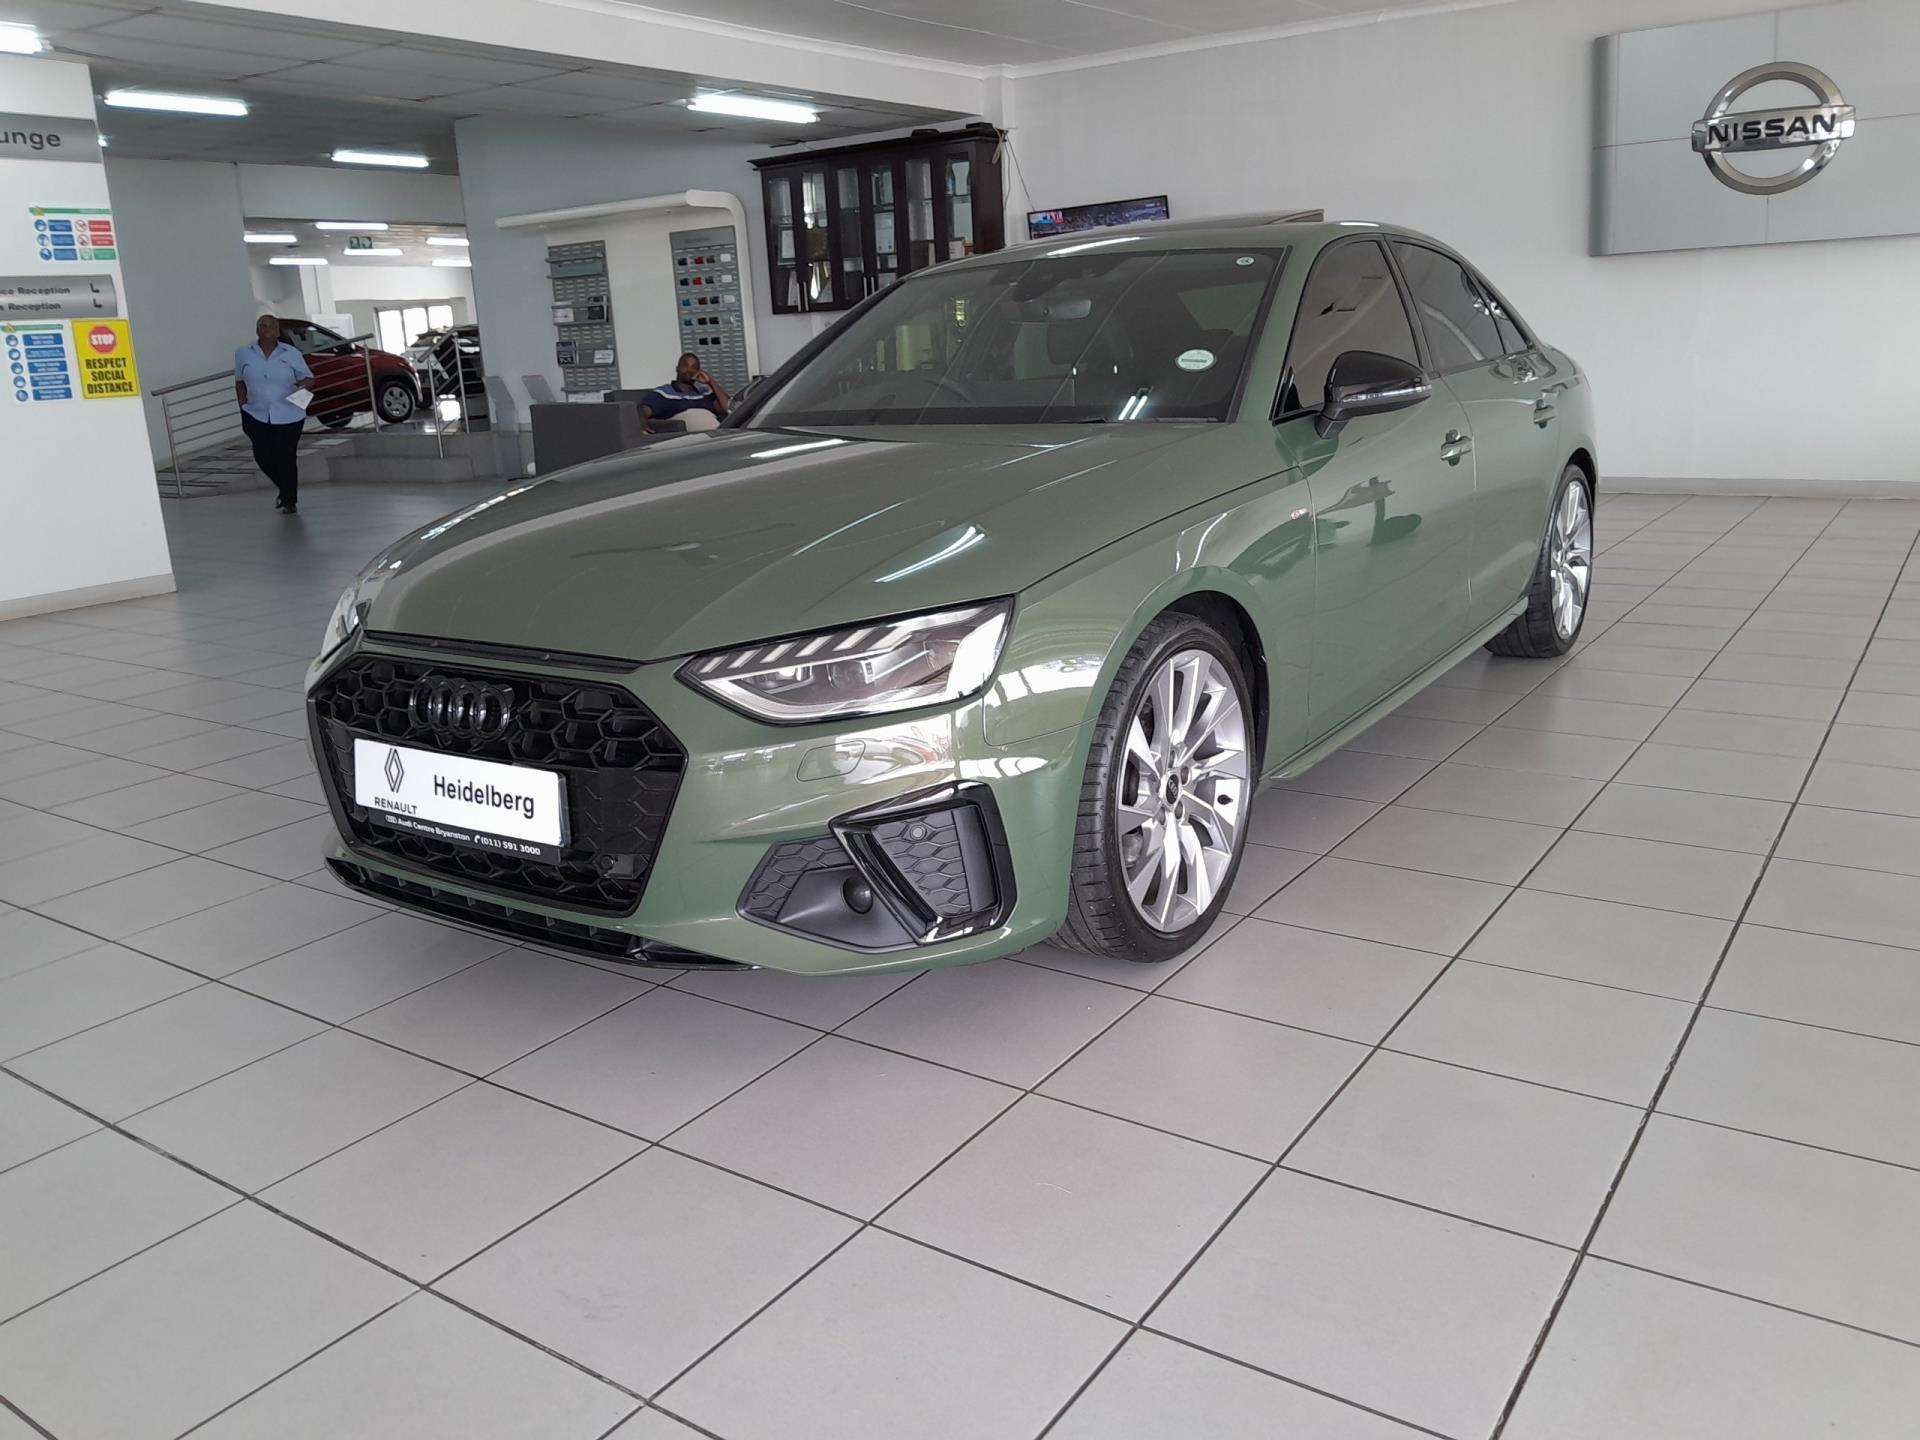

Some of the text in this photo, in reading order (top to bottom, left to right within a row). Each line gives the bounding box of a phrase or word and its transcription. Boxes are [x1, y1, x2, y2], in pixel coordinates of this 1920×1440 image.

[1708, 113, 1837, 144] NISSAN
[17, 286, 71, 296] Reception
[8, 302, 62, 311] Reception
[91, 333, 115, 346] STOP
[85, 357, 127, 369] RESPECT
[91, 370, 126, 382] SOCIAL
[87, 381, 134, 394] DISTANCE
[433, 774, 535, 819] Heidelberg
[374, 796, 418, 815] RENAULT
[398, 818, 541, 856] Audi Centre Bryanston (011) 591 3000
